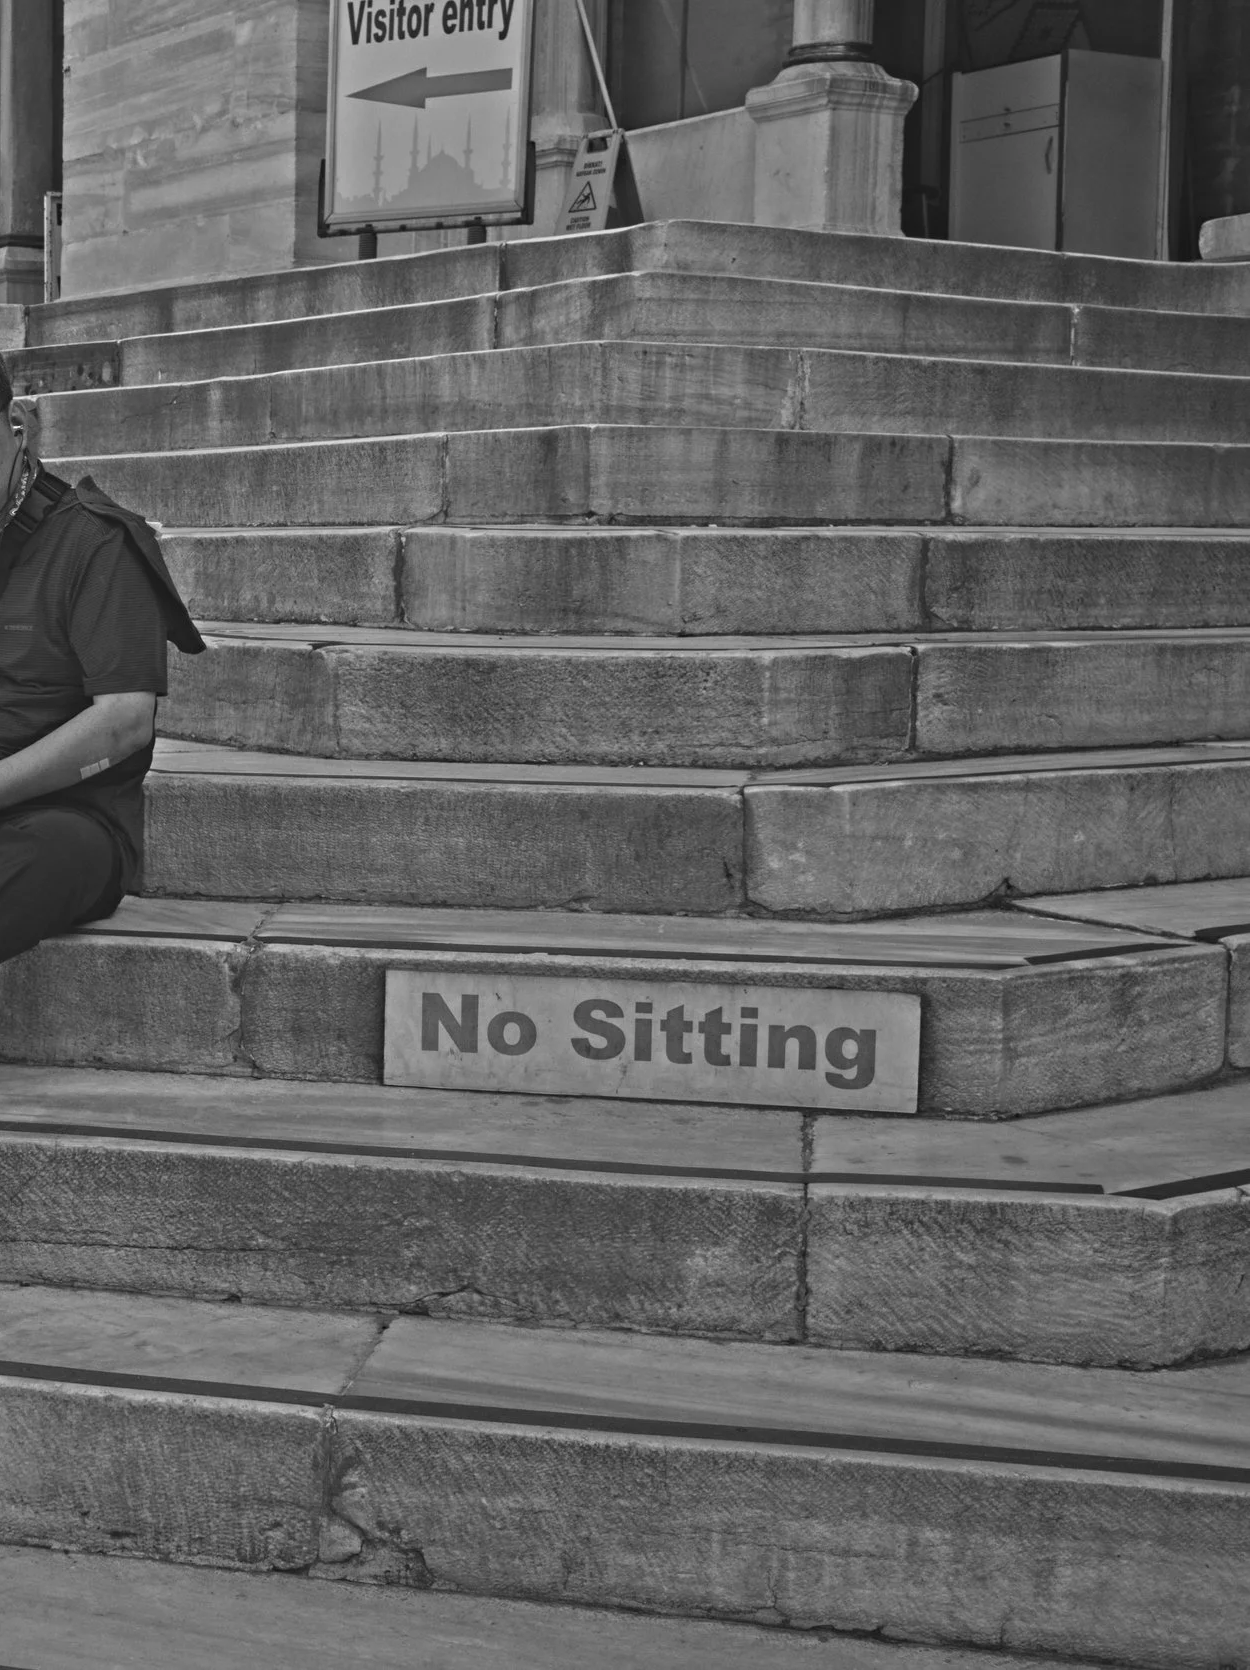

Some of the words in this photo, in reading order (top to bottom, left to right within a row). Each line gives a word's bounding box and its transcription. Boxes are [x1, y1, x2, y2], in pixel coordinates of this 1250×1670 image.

[347, 0, 434, 45] Visitor
[442, 0, 514, 41] entry
[421, 992, 537, 1055] No
[570, 999, 877, 1090] Sitting
